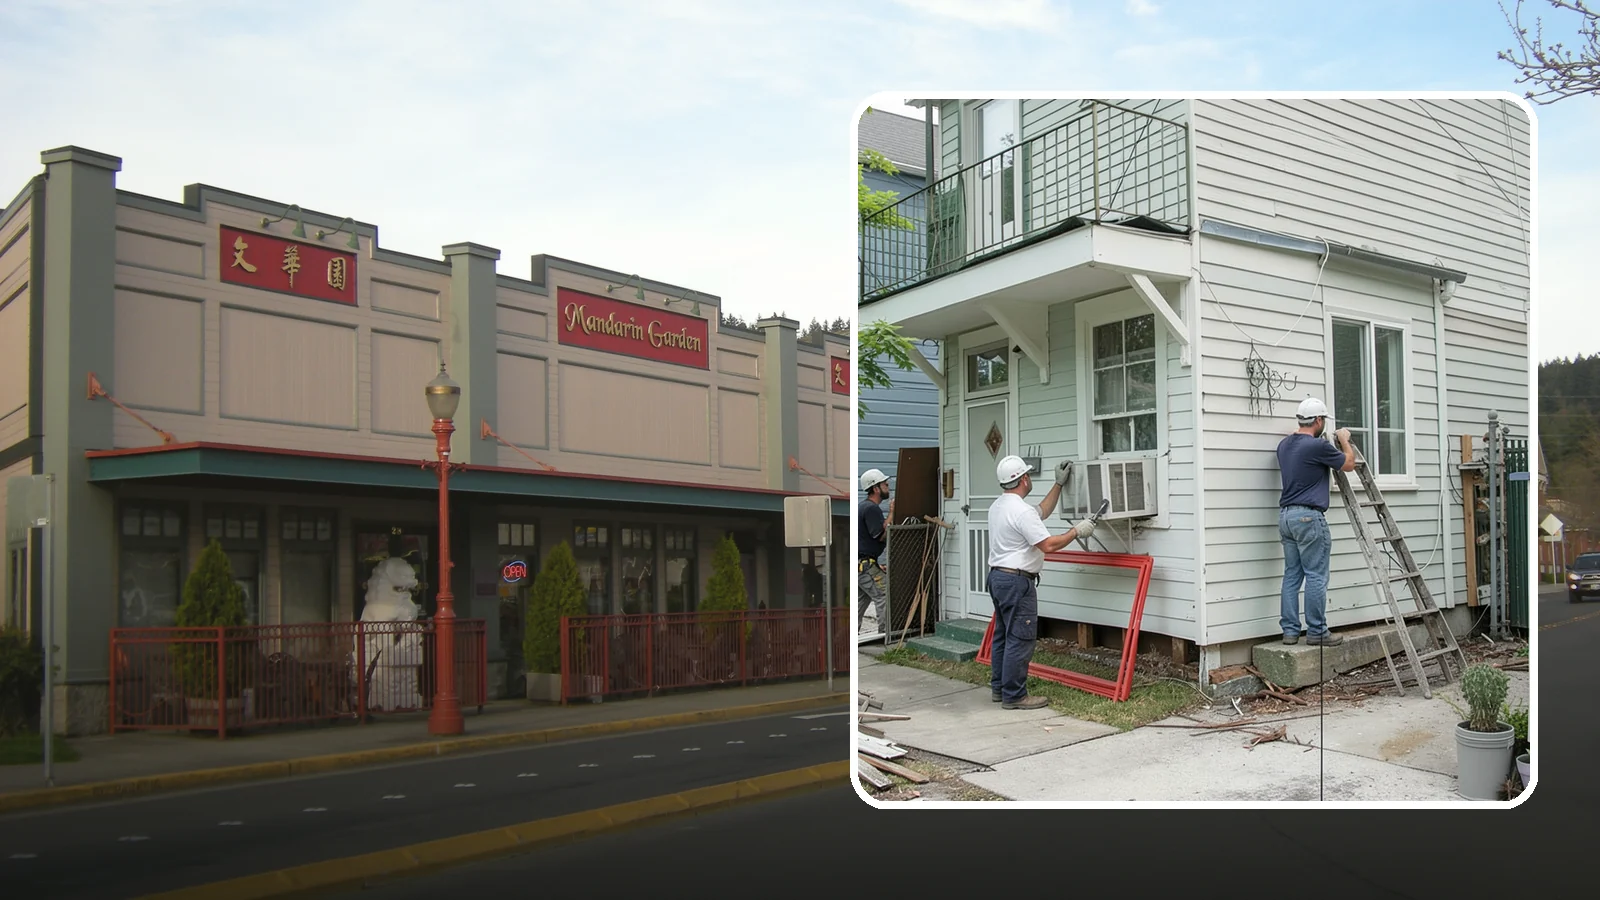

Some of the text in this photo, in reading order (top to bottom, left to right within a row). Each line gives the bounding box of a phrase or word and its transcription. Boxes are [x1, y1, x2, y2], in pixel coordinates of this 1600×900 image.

[231, 236, 346, 291] 文華園
[564, 302, 701, 352] Mandarin Garden
[503, 565, 527, 578] OPEN
